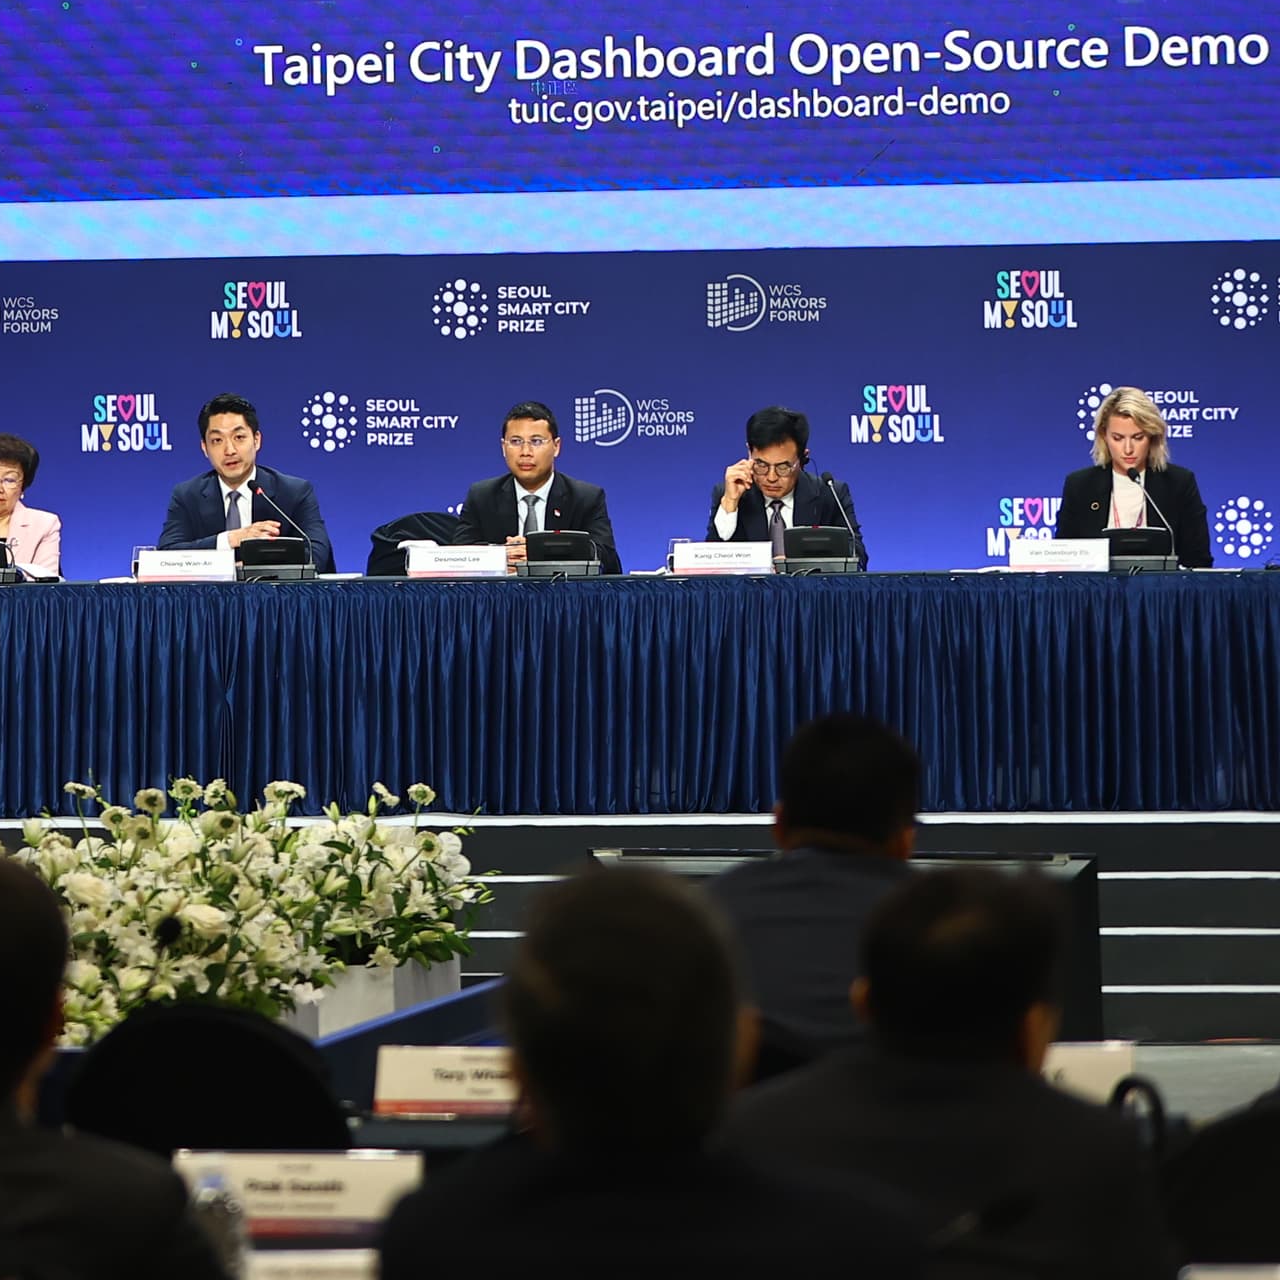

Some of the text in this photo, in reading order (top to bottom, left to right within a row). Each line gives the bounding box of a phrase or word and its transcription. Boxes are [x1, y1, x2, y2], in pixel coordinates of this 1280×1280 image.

[253, 25, 1269, 97] Taipei City Dashboard Open-Source Demo
[507, 81, 1011, 131] tuic.gov.taipei/dashboard-demo
[498, 286, 551, 298] SEOUL
[769, 285, 801, 296] WCS
[3, 297, 34, 308] WCS
[498, 302, 590, 315] SMART CITY
[770, 298, 826, 308] MAYORS
[4, 309, 58, 320] MAYORS
[770, 310, 819, 321] FORUM
[1021, 300, 1077, 328] SOUL
[4, 321, 51, 333] FORUM
[248, 310, 302, 338] SOUL
[498, 320, 544, 332] PRIZE
[1144, 391, 1199, 404] SEOUL
[366, 399, 419, 411] SEOUL
[637, 399, 669, 410] WCS
[638, 411, 694, 423] MAYORS
[1160, 408, 1239, 420] MART CITY
[367, 416, 458, 428] SMART CITY
[638, 424, 687, 436] FORUM
[888, 414, 944, 443] SOUL
[1167, 425, 1193, 437] IZE
[118, 423, 172, 451] SOUL
[367, 433, 413, 445] PRIZE
